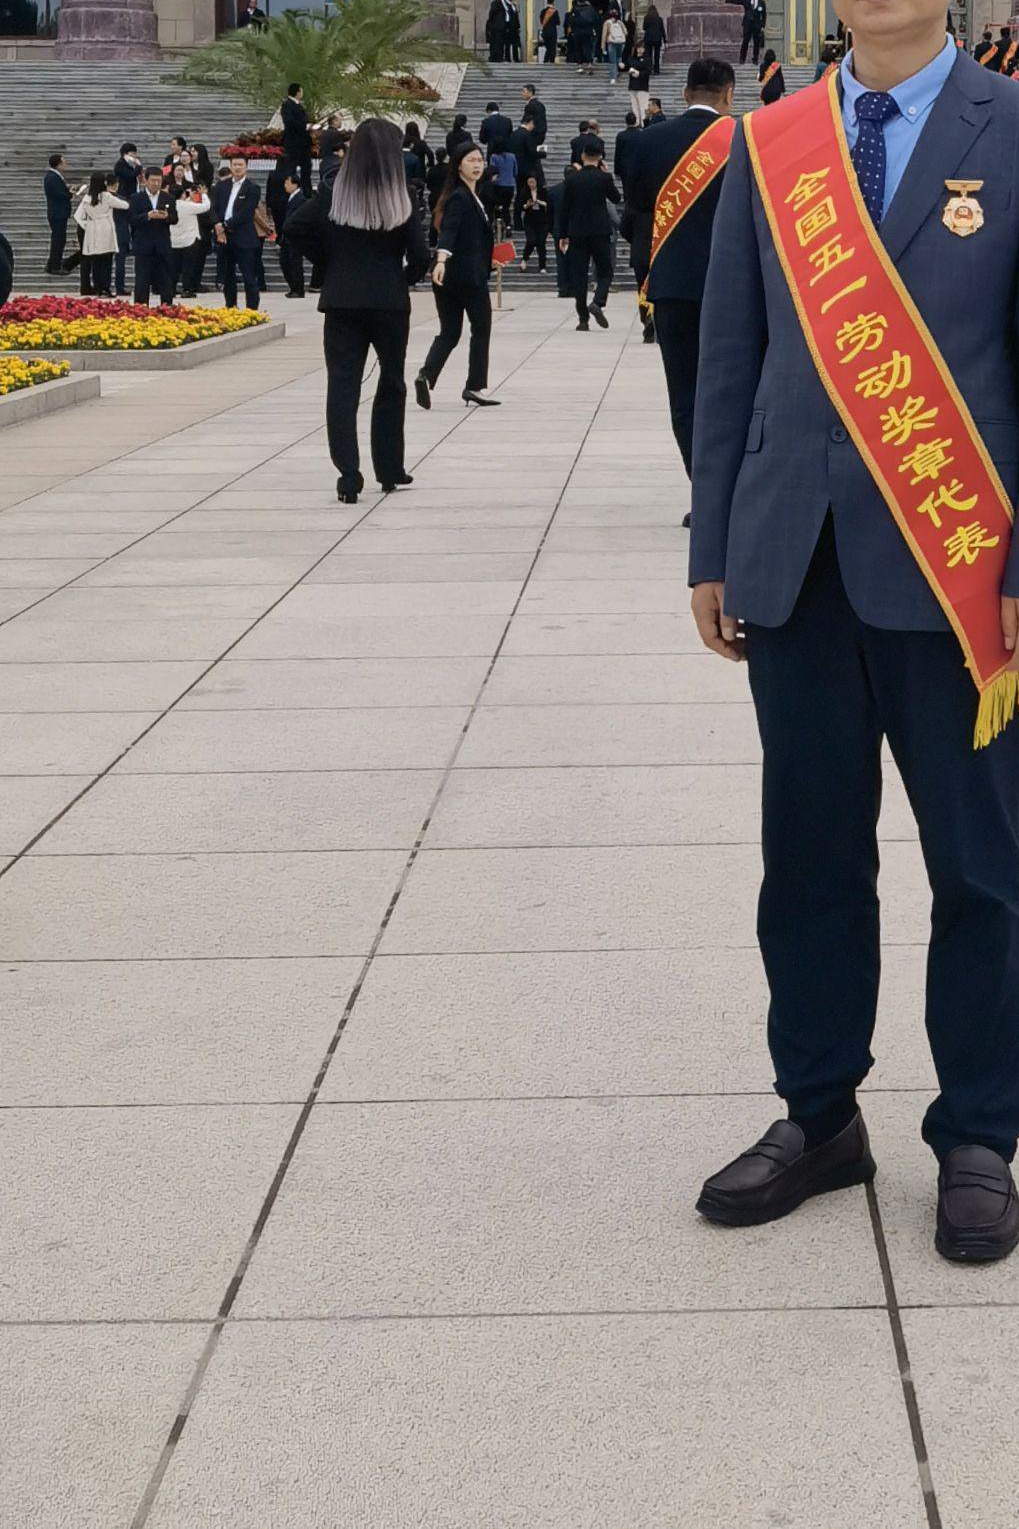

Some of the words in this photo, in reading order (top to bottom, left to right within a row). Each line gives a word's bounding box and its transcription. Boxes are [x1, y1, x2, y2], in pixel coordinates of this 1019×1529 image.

[783, 167, 999, 568] 全国五一劳动奖章代表
